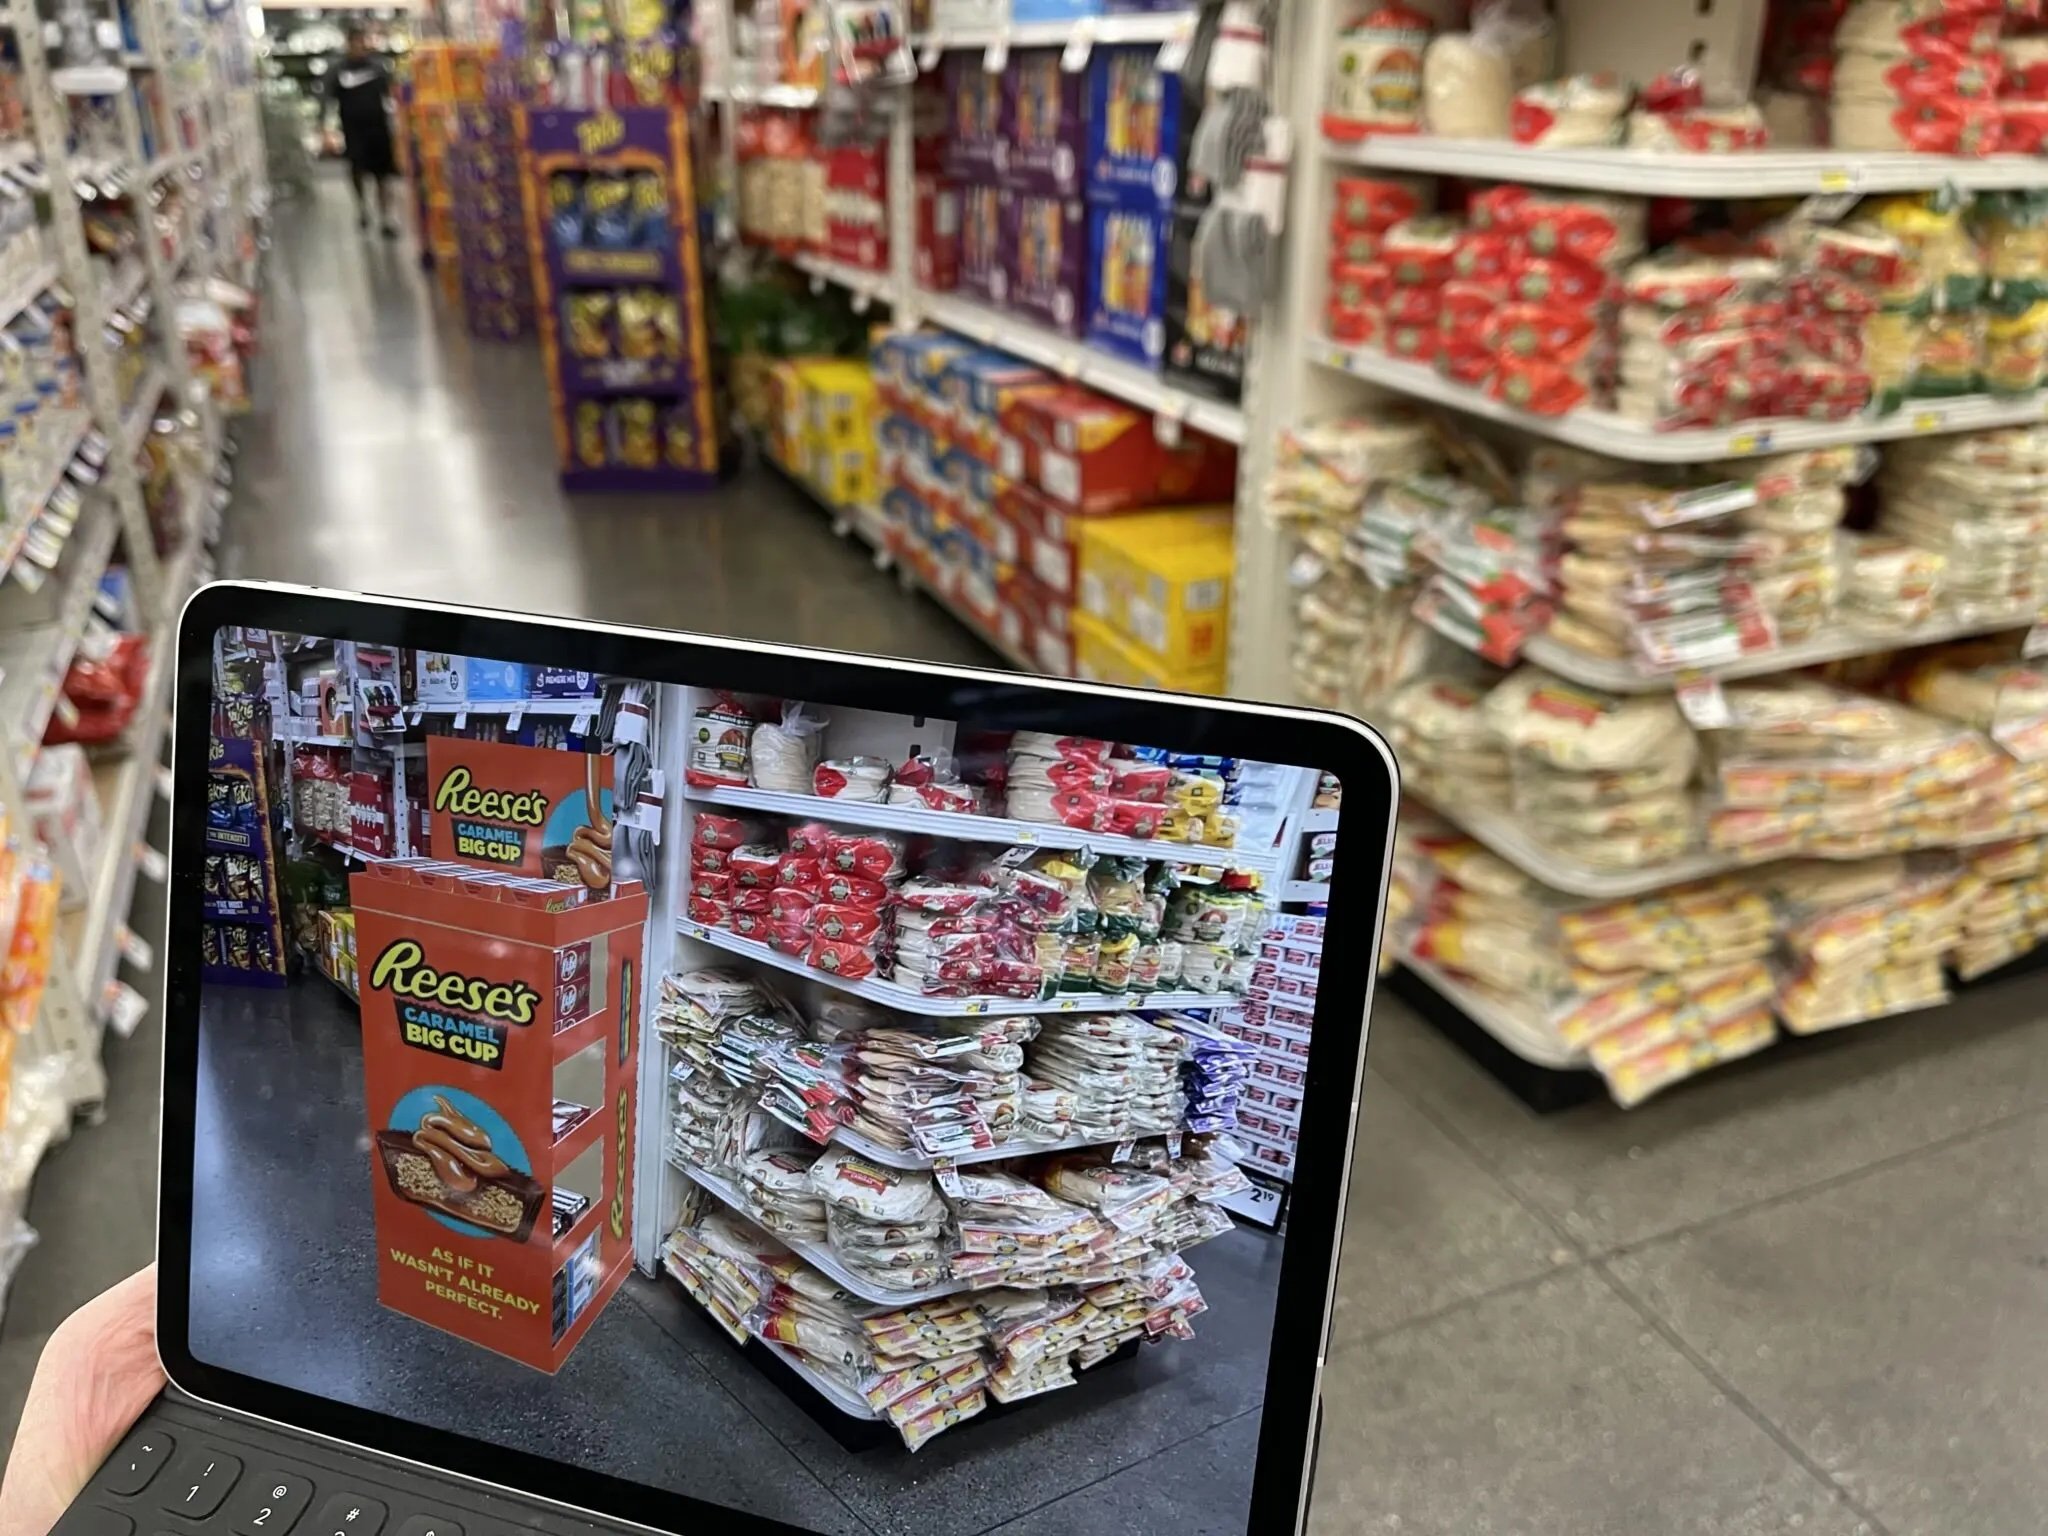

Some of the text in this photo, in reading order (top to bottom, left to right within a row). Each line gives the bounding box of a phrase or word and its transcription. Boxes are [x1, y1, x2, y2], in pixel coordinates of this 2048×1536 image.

[458, 823, 522, 845] CARAMEL
[459, 838, 522, 862] BIG CUP
[404, 1006, 500, 1044] CARAMEL
[405, 1022, 499, 1062] BIG CUP
[431, 1247, 494, 1279] AS IF IT
[390, 1247, 540, 1316] WASN'T ALREADY
[425, 1279, 503, 1320] PERFECT.
[186, 1485, 200, 1502] 1
[272, 1485, 287, 1499] @
[253, 1507, 272, 1526] 2
[345, 1507, 360, 1523] #
